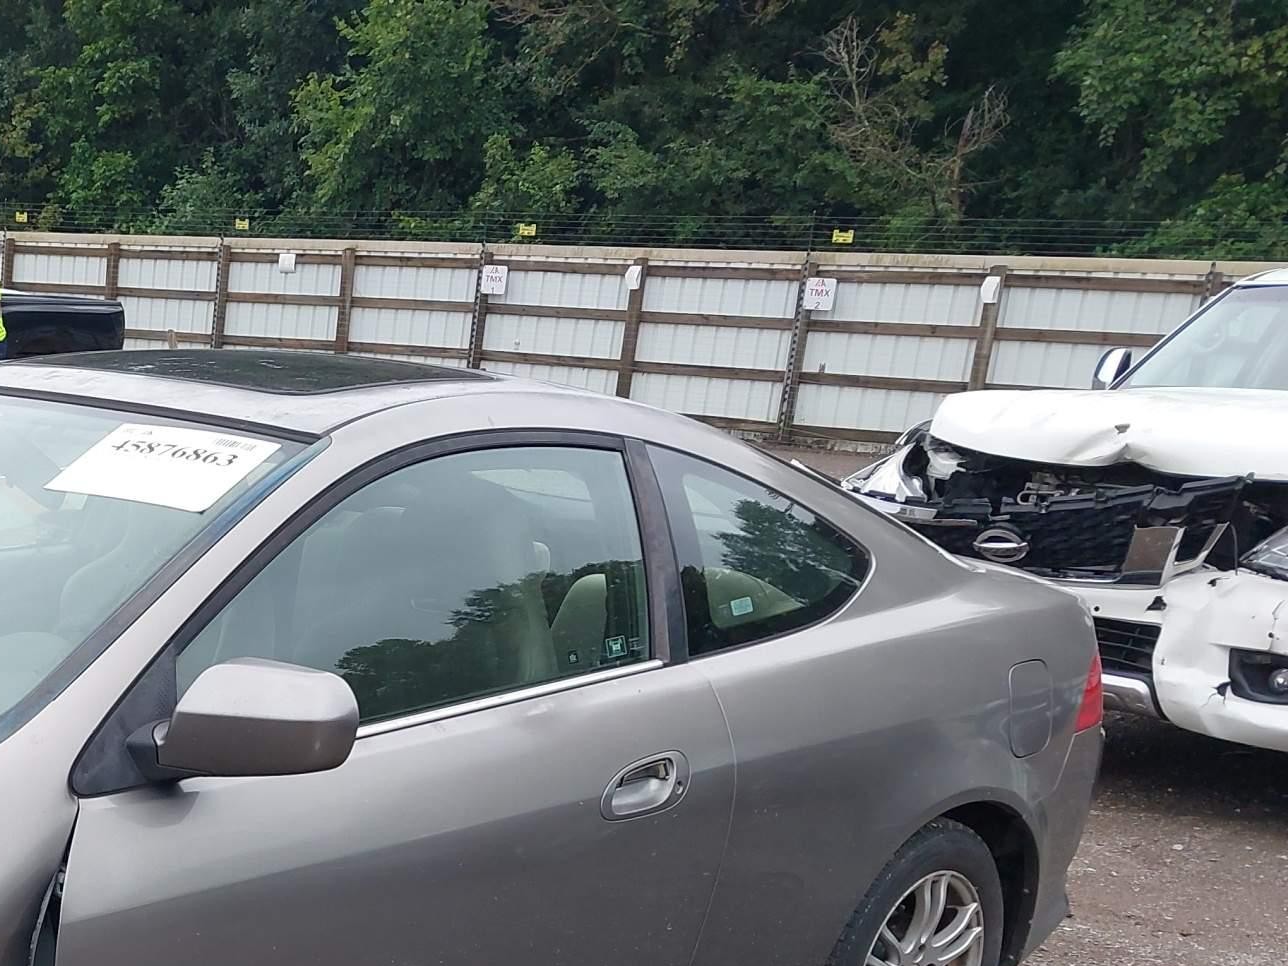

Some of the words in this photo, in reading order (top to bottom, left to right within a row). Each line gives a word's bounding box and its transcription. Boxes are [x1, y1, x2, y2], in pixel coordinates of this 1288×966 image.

[485, 274, 503, 283] TMX
[809, 288, 831, 297] TMX
[814, 301, 821, 310] 2
[111, 438, 239, 468] 45876863
